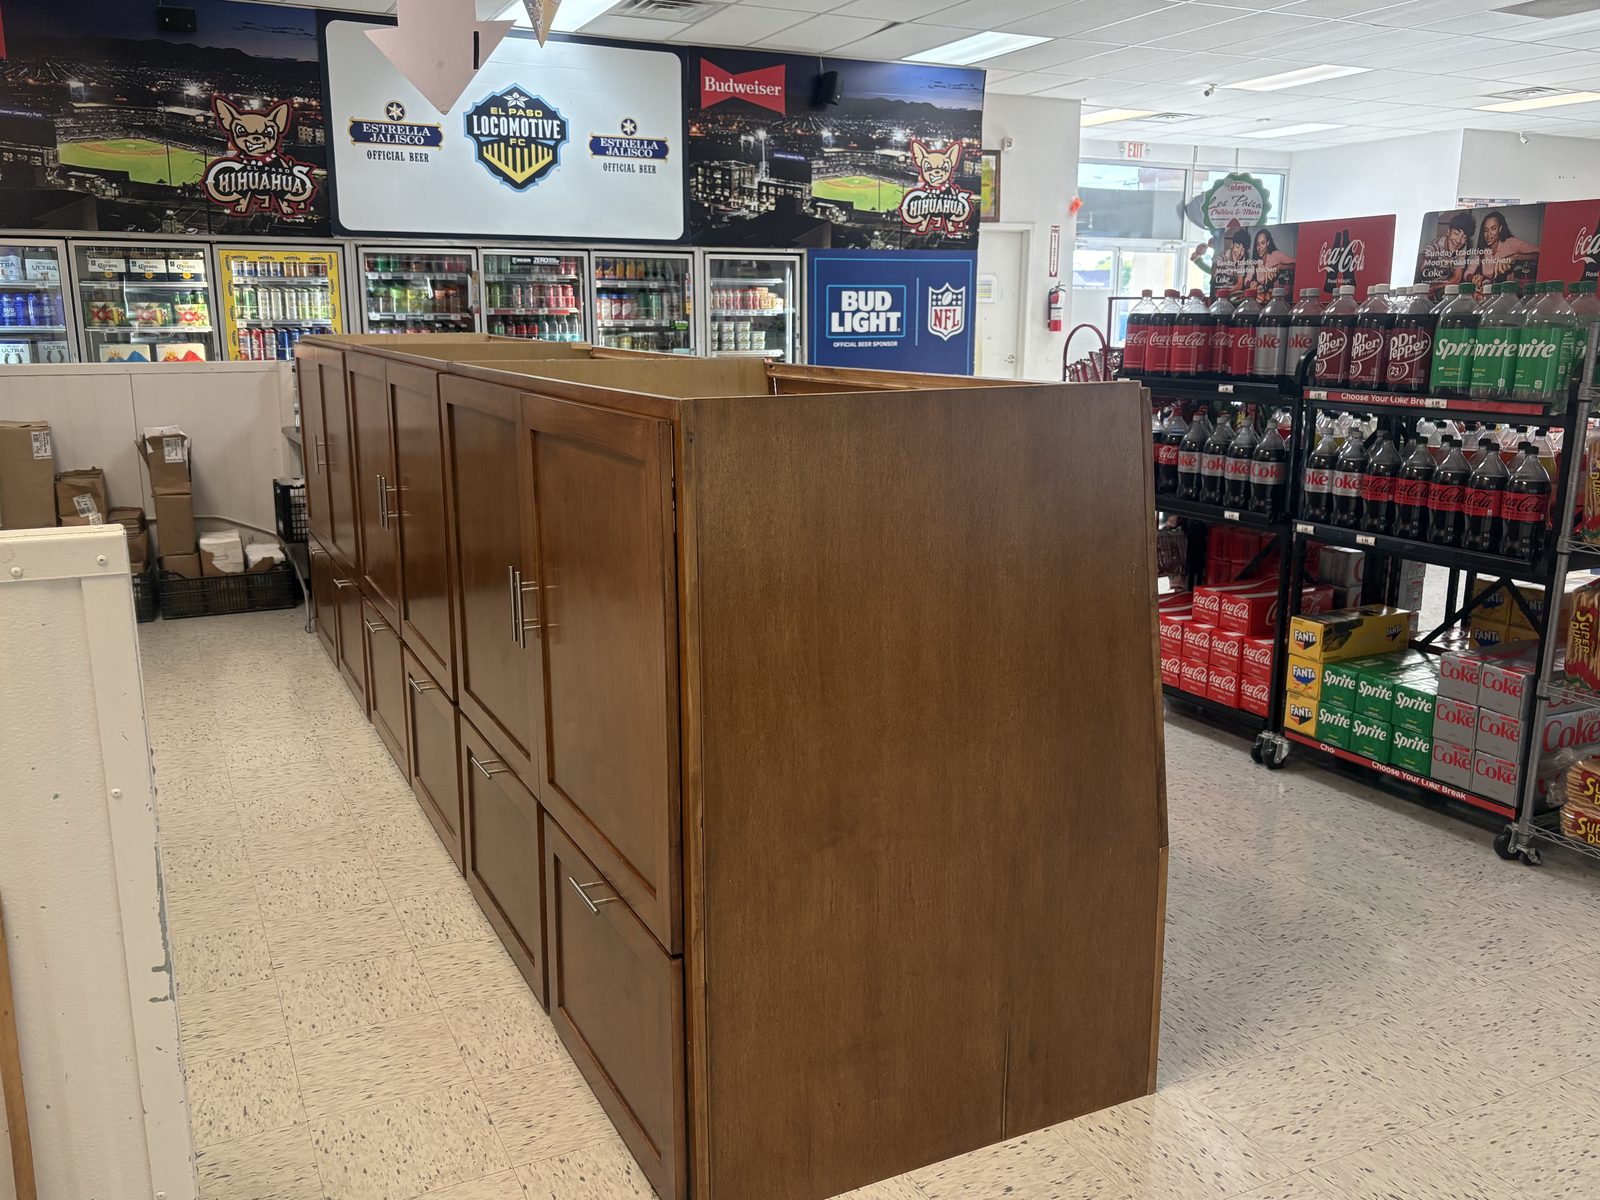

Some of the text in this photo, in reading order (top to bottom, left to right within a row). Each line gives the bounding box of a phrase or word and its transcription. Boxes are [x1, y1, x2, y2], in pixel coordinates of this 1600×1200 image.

[704, 76, 781, 96] Budweiser
[490, 107, 542, 117] EL PASO
[362, 123, 431, 136] ESTRELLA
[473, 115, 561, 139] LOCOMOTIVE
[370, 133, 424, 145] JALISCO
[509, 138, 526, 146] FC
[600, 138, 658, 150] ESTRELLA
[367, 150, 429, 162] OFFICIAL BEER
[606, 147, 653, 158] JALISCO
[1128, 142, 1144, 158] EXIT
[603, 162, 657, 174] OFFICIAL BEER
[206, 161, 313, 202] CHIHUAHUAS
[901, 191, 970, 224] CHIHUAHUAS
[1318, 239, 1365, 273] Coca-Cola
[1425, 248, 1492, 258] Sunday traditions
[1422, 268, 1443, 278] Coke
[841, 290, 892, 311] BUD
[831, 312, 901, 332] LIGHT
[933, 308, 960, 330] NFL
[1389, 336, 1428, 361] Pepper
[1399, 333, 1416, 347] Dr
[1341, 391, 1369, 402] Choose
[1371, 394, 1389, 403] Your
[1410, 397, 1425, 406] Bre
[1487, 592, 1504, 604] NTA
[1294, 630, 1317, 642] FANTA
[1474, 628, 1501, 642] FANTA
[1570, 621, 1582, 649] DURO
[1576, 610, 1593, 654] SUPER
[1293, 665, 1316, 679] FANTA
[1323, 670, 1356, 690] Sprite
[1441, 660, 1479, 685] Coke
[1358, 681, 1392, 701] Sprite
[1482, 671, 1521, 698] Coke
[1290, 704, 1313, 718] FANTA
[1395, 692, 1432, 713] Sprite
[1318, 708, 1350, 728] Sprite
[1436, 703, 1475, 728] Coke
[1352, 720, 1387, 741] Sprite
[1479, 715, 1520, 742] Coke
[1393, 732, 1429, 753] Sprite
[1433, 745, 1471, 770] Coke
[1371, 760, 1399, 777] Choose
[1401, 771, 1420, 784] Your
[1441, 785, 1466, 800] Break
[1475, 758, 1516, 785] Coke
